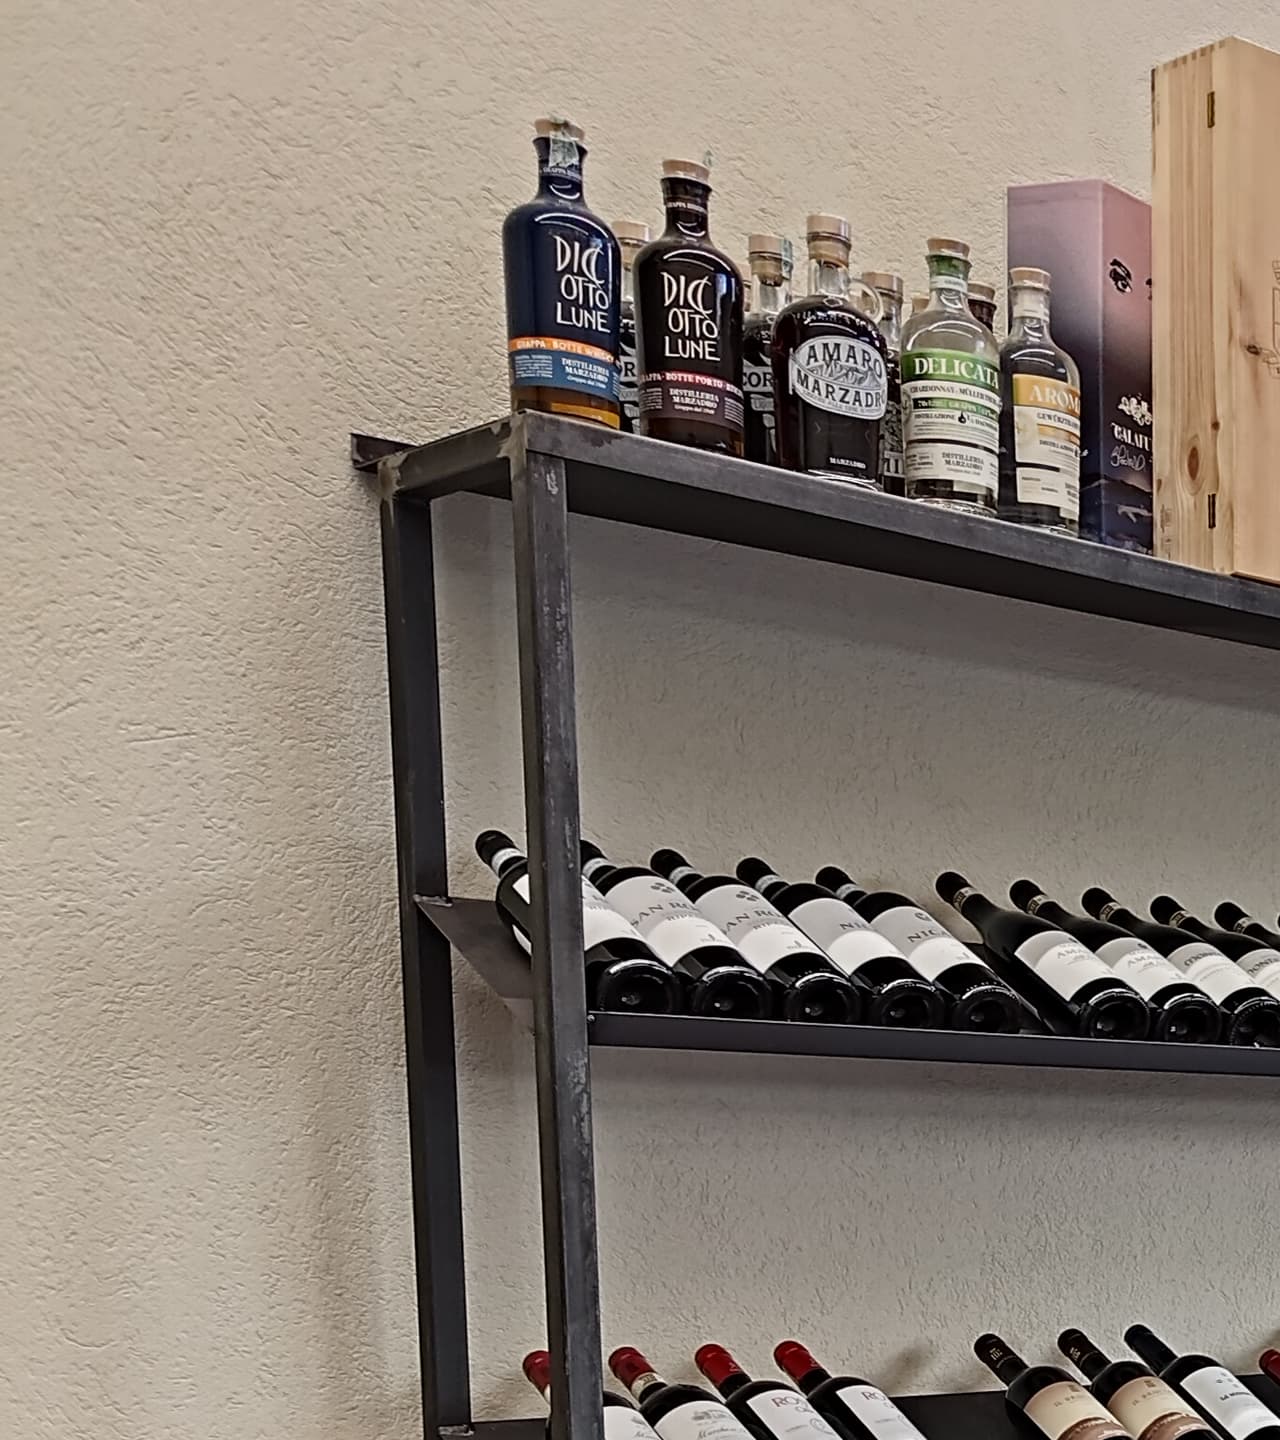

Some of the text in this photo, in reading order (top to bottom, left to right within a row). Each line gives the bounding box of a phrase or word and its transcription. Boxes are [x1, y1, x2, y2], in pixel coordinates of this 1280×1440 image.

[560, 273, 609, 310] OTTO
[555, 302, 611, 333] LUNE
[668, 307, 719, 338] OTTO
[664, 336, 721, 362] LUNE
[806, 342, 883, 379] AMARO
[665, 372, 695, 383] BOTTE
[695, 375, 724, 389] PORTO
[914, 357, 999, 389] DELICATA
[910, 384, 955, 394] CHARDONNAY
[829, 456, 867, 470] MARZADRO
